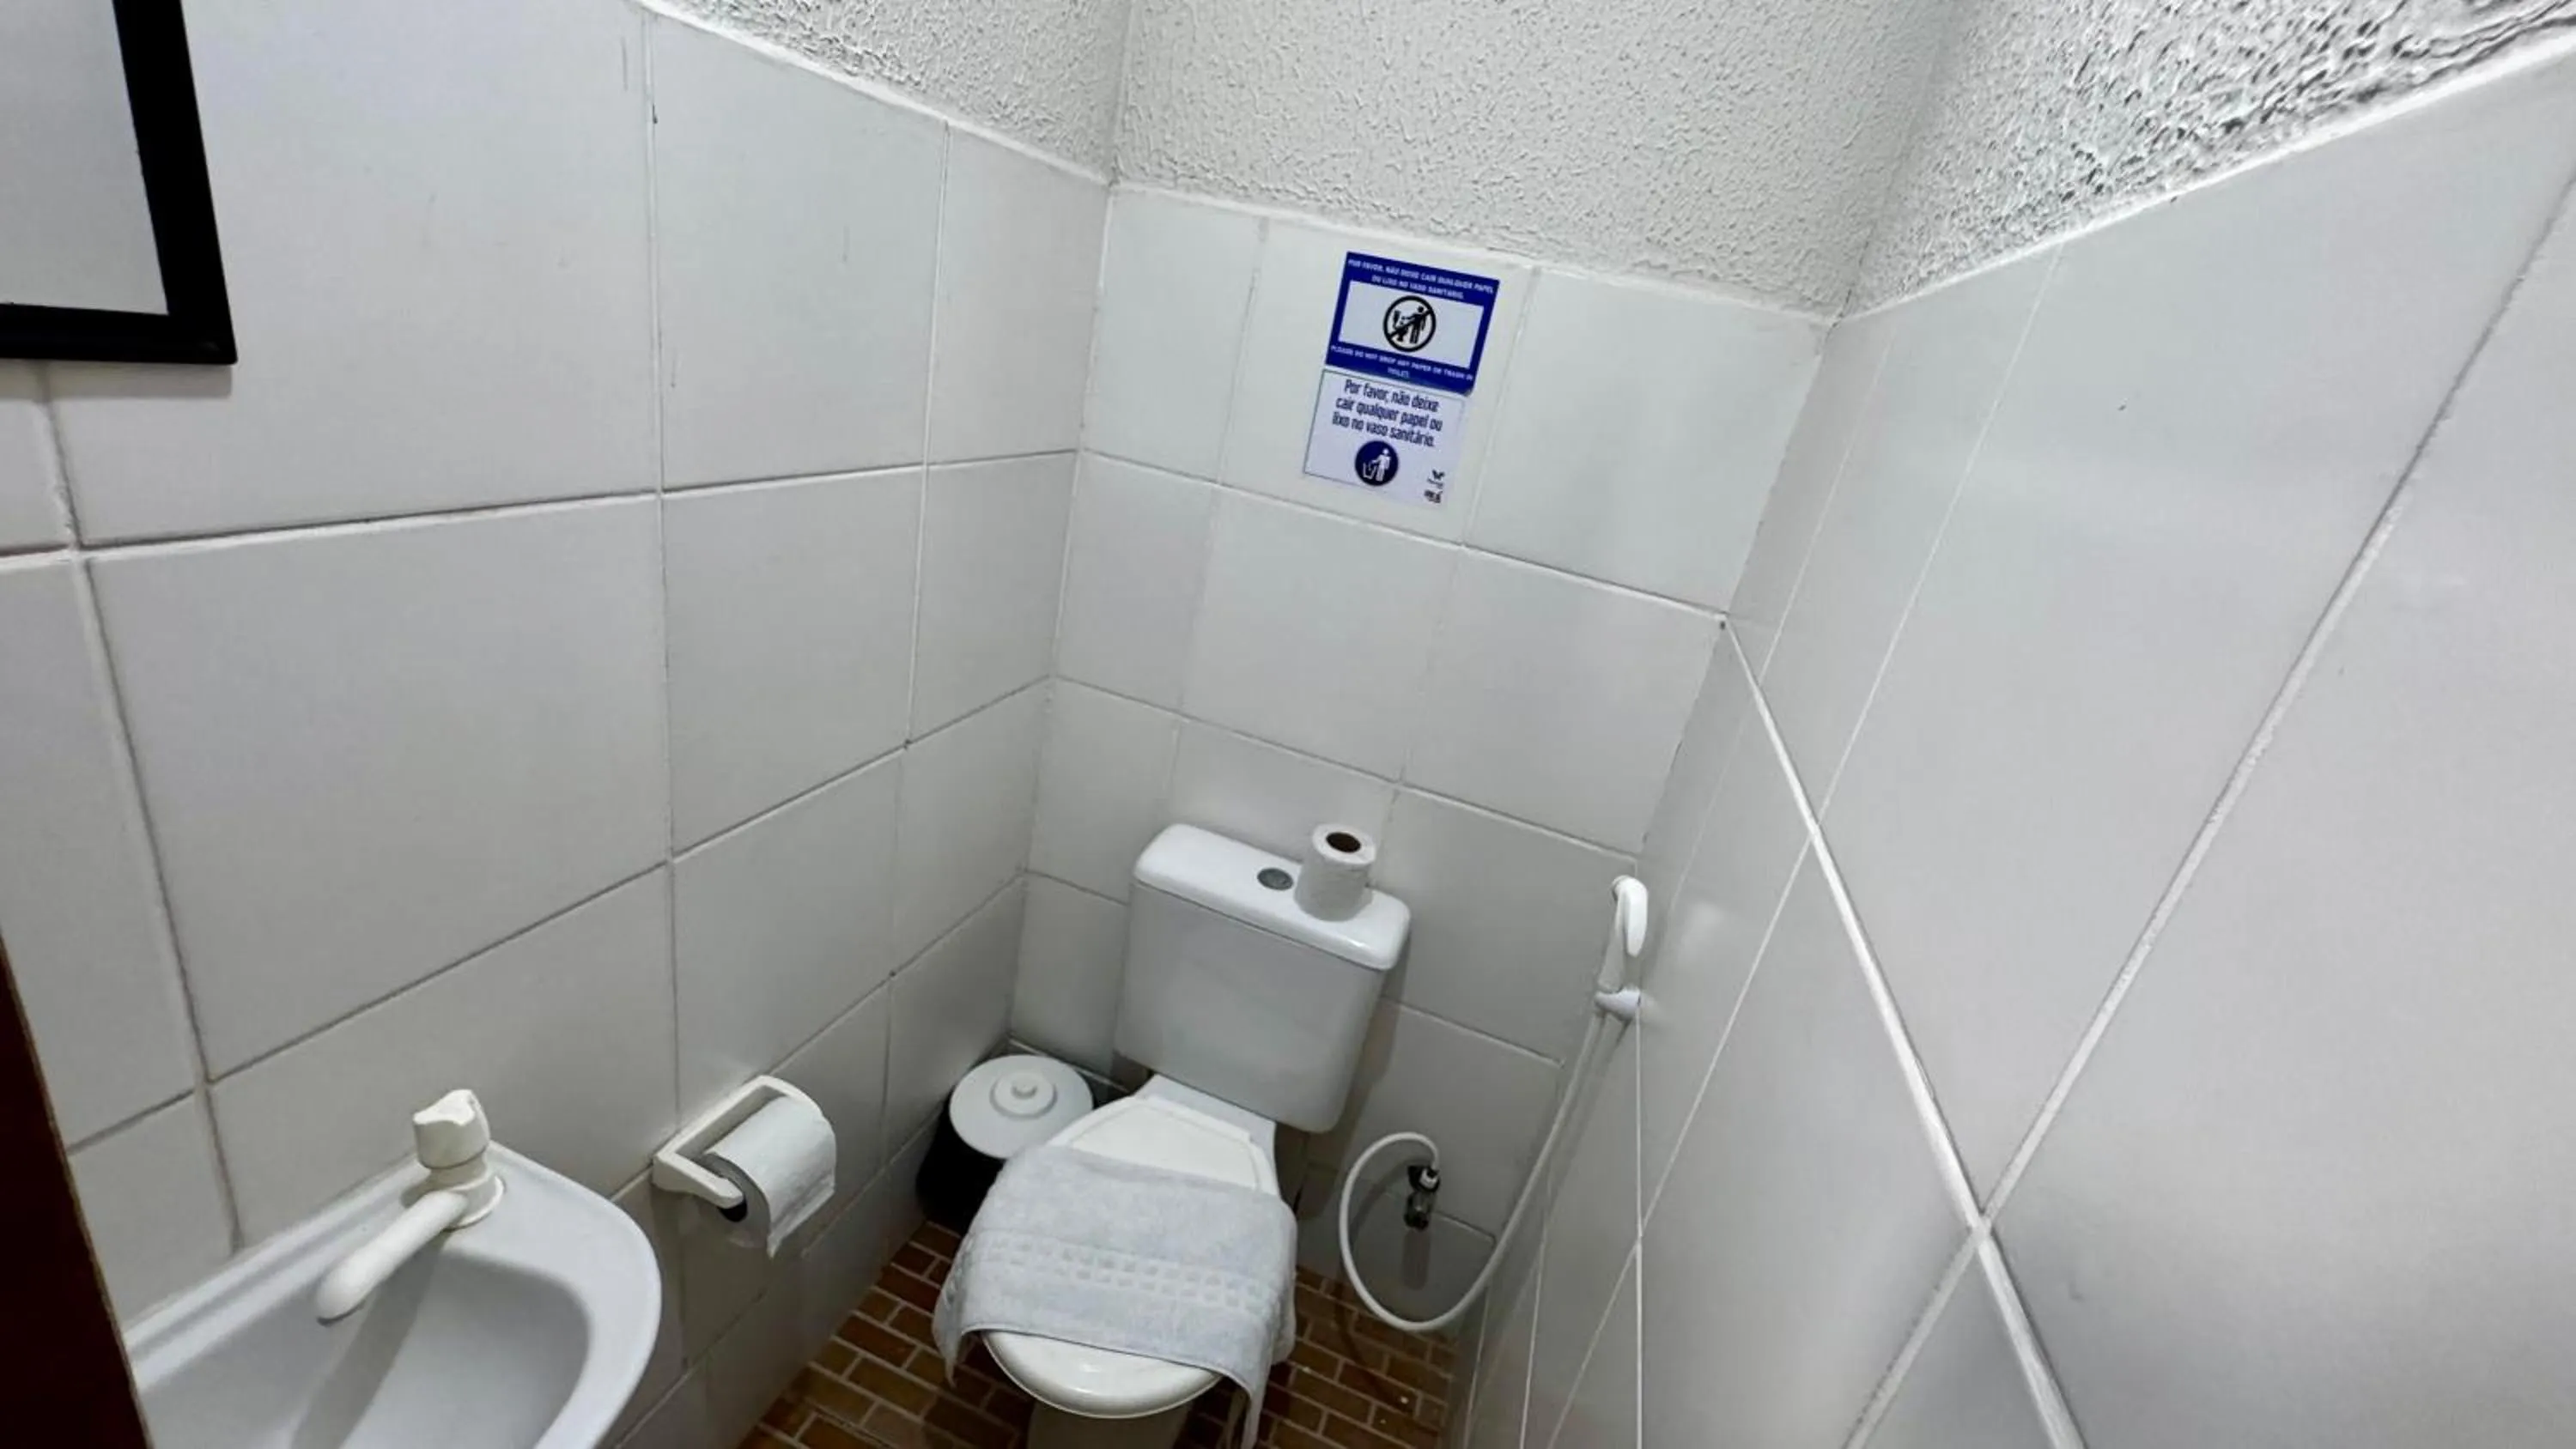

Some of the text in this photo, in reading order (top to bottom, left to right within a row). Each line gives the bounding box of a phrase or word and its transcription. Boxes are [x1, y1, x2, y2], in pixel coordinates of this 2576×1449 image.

[1345, 379, 1362, 394] Por
[1364, 382, 1388, 404] favor,
[1390, 390, 1410, 406] não
[1332, 411, 1351, 428] lixo
[1352, 417, 1364, 431] no
[1366, 421, 1388, 437] vaso
[1336, 396, 1443, 432] cair qualquer papel ou
